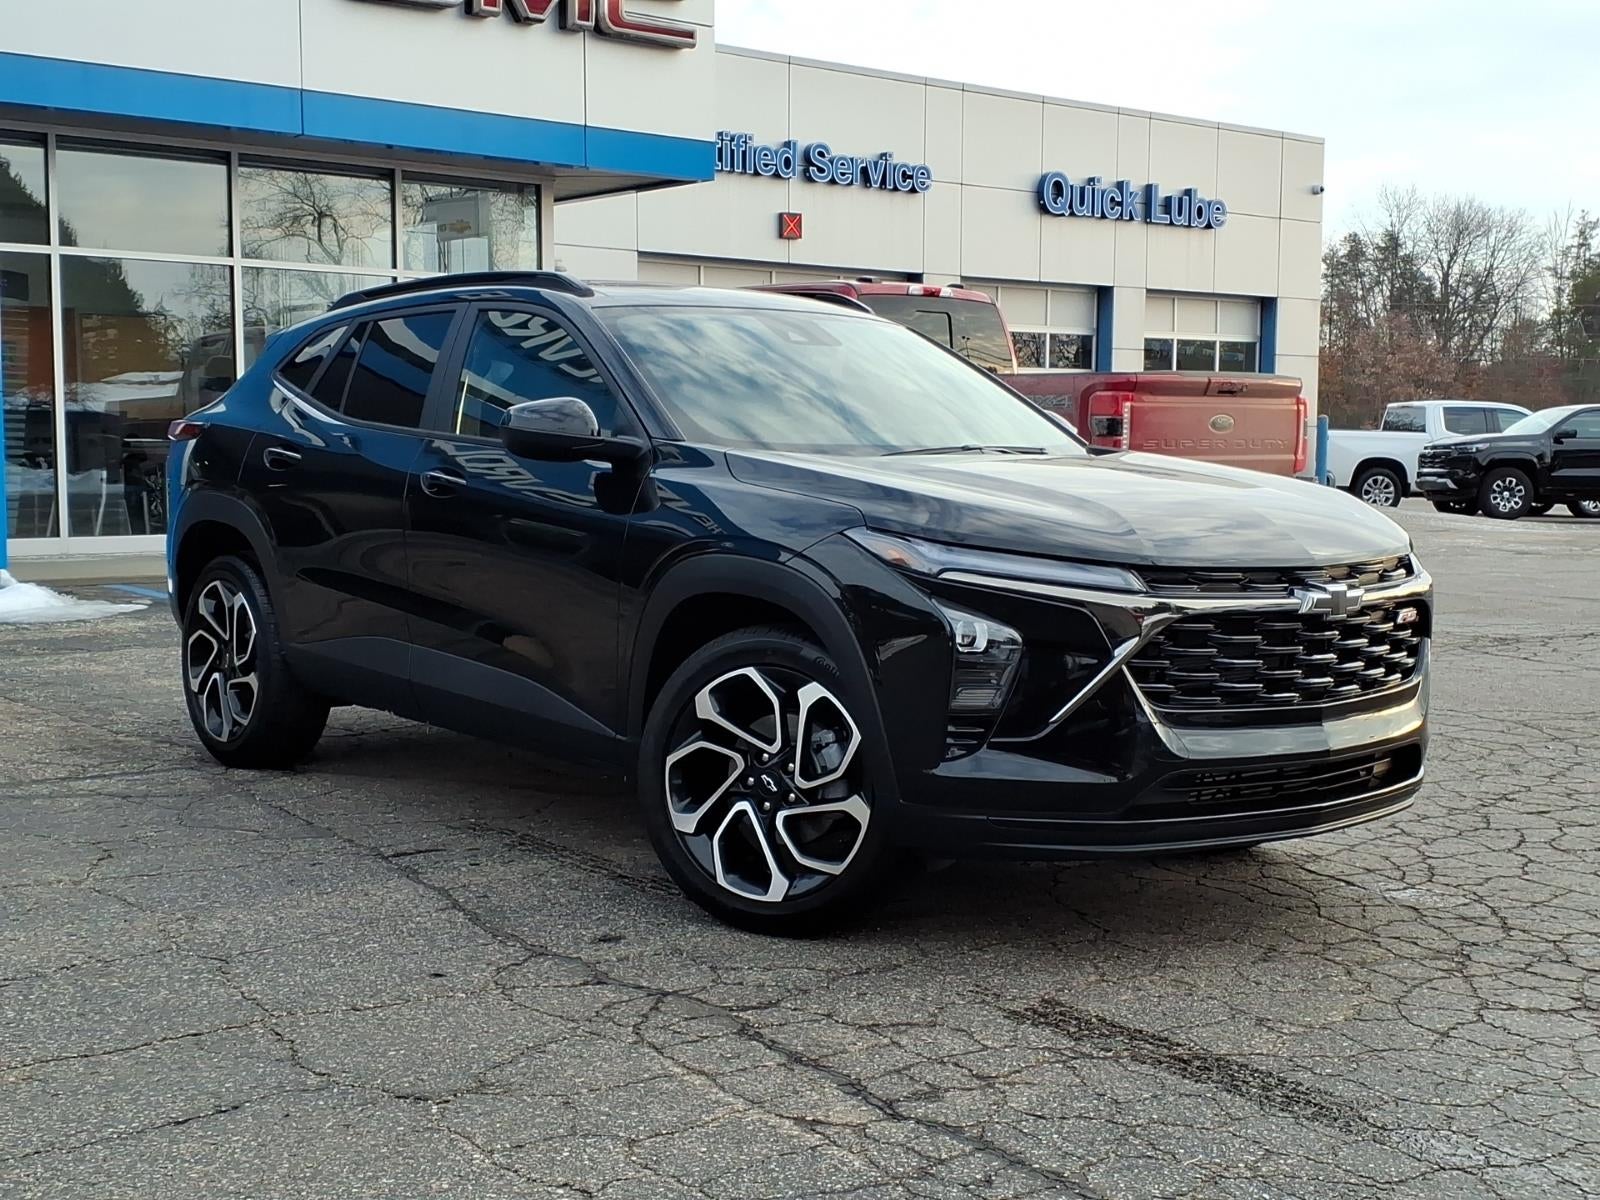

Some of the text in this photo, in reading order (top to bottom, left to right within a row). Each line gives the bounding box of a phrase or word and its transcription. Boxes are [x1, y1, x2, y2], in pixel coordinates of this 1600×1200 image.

[806, 142, 933, 193] Service
[1040, 170, 1229, 230] Quick Lube
[1143, 438, 1289, 450] SUPER DUTY
